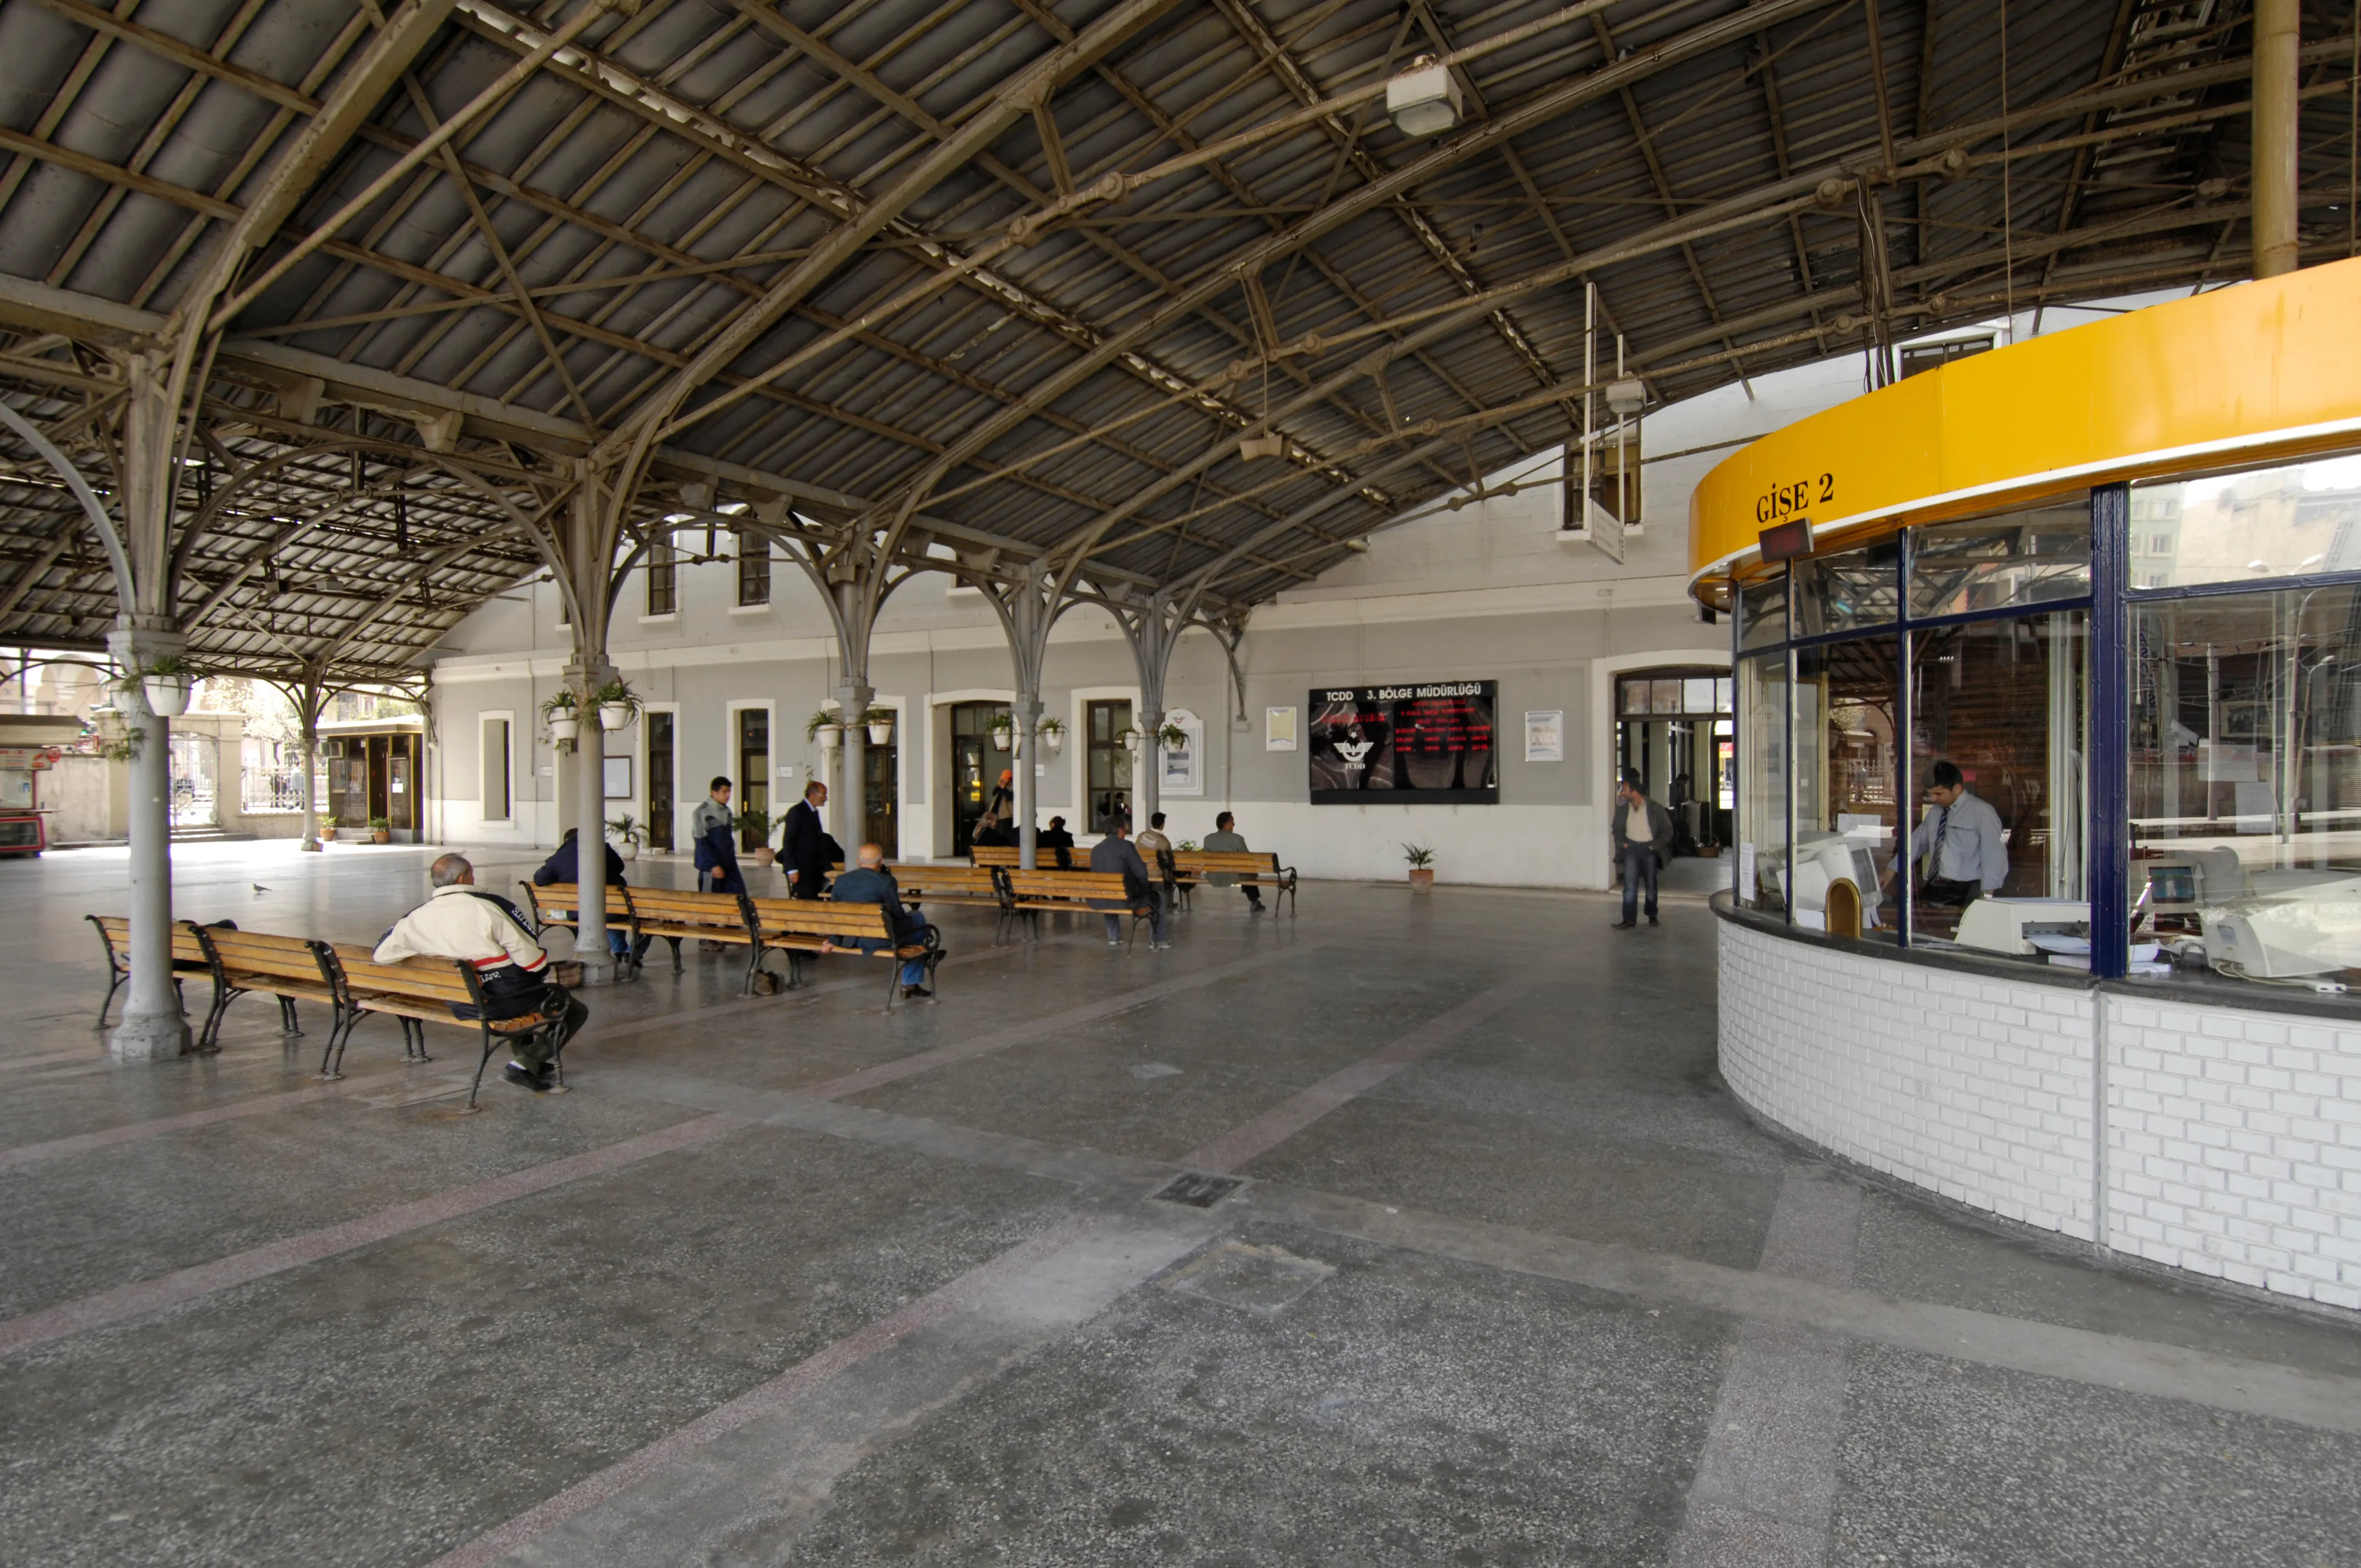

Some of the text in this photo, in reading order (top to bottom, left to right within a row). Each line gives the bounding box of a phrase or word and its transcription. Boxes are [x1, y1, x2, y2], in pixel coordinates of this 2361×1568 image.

[1756, 473, 1834, 523] GİŞE 2
[1326, 682, 1481, 701] TCDD 3. BÖLGE MÜDÜRLÜĞÜ
